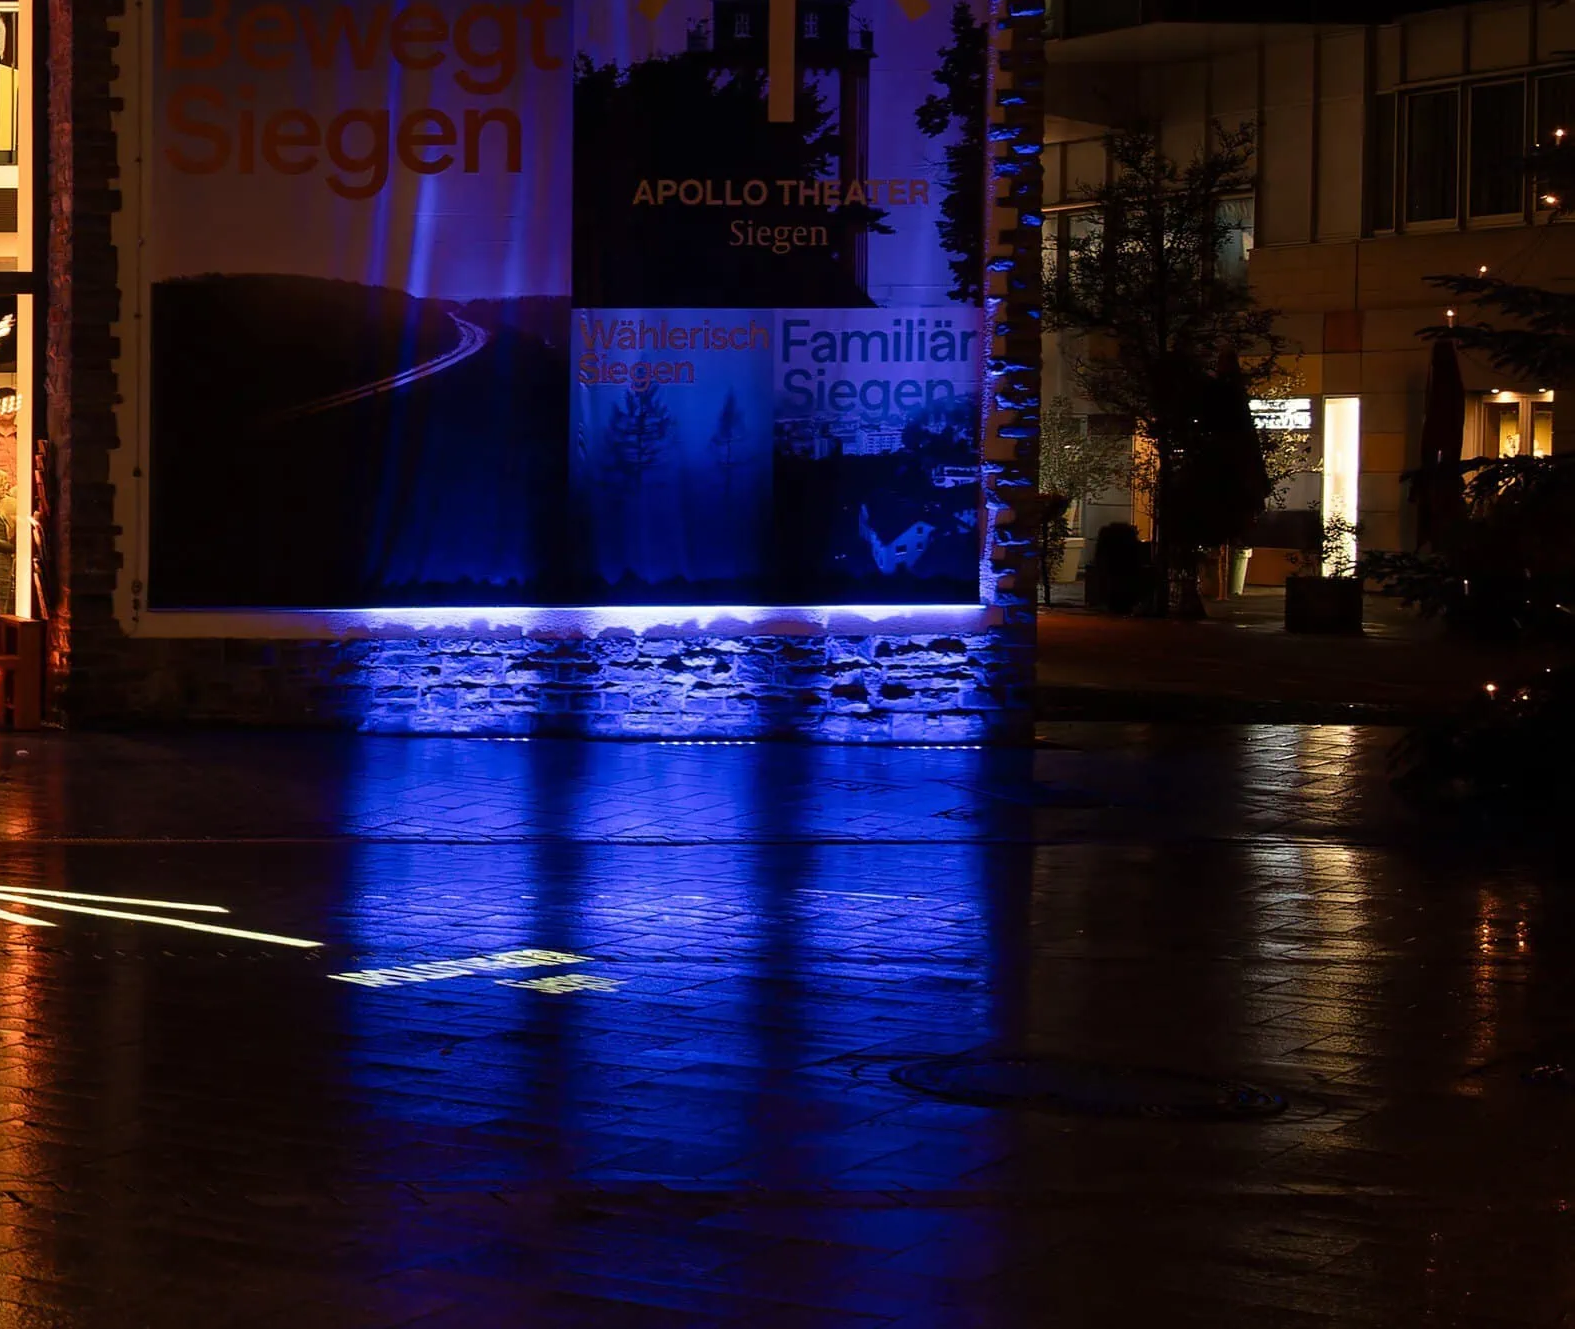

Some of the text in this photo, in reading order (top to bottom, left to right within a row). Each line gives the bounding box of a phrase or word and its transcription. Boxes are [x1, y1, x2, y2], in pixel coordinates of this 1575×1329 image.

[164, 83, 522, 200] Siegen
[632, 178, 930, 206] APOLLO THEATER
[728, 219, 830, 255] Siegen
[579, 319, 769, 351] Wählerisch
[782, 318, 977, 364] Familiär
[578, 353, 695, 392] Siegen
[783, 369, 954, 424] Siegen
